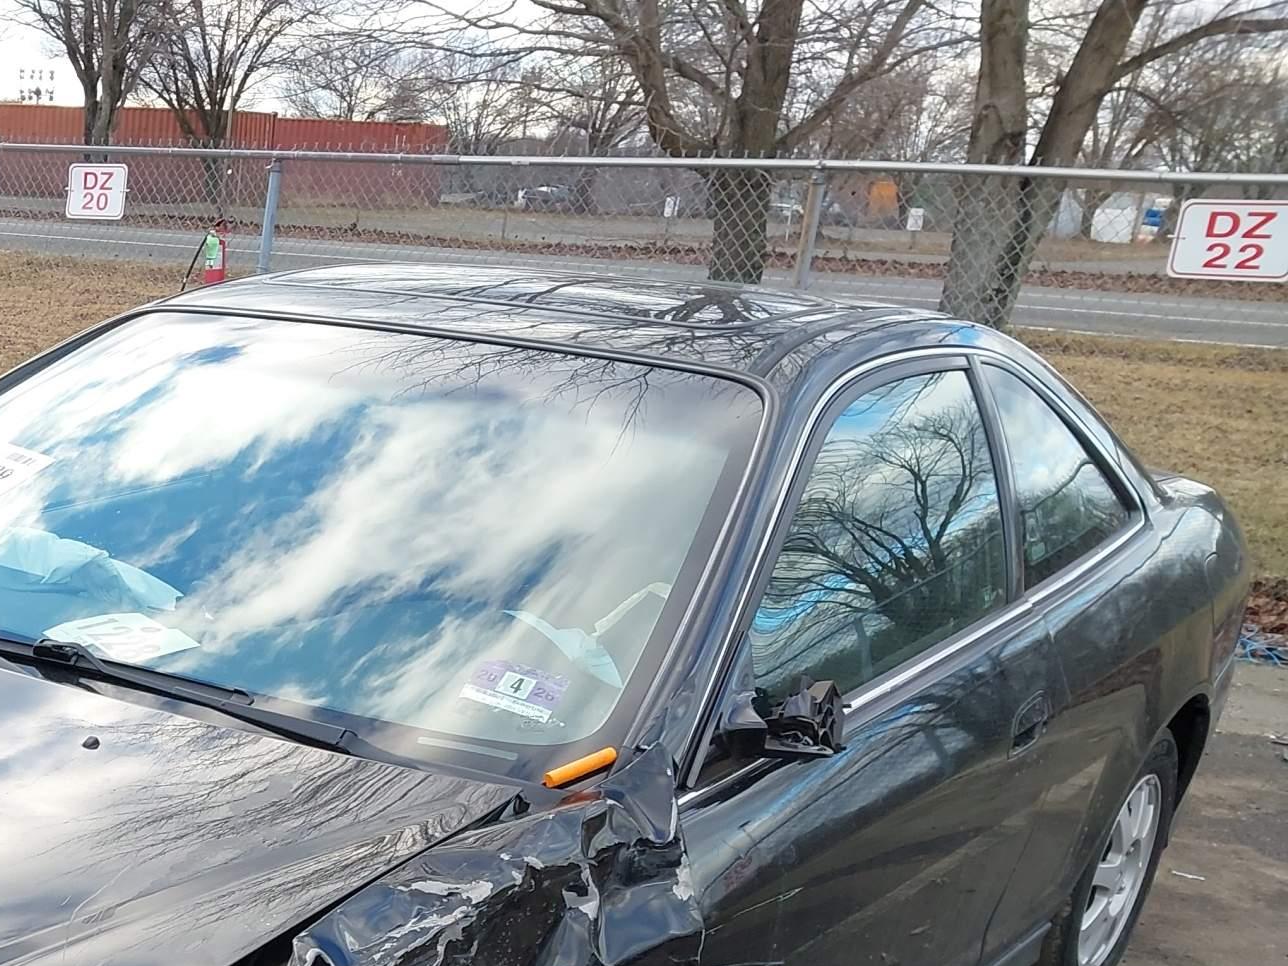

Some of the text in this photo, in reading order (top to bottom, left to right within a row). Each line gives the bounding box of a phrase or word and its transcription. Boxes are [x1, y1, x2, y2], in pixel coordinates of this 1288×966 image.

[83, 172, 114, 190] DZ
[81, 192, 109, 211] 20
[1205, 211, 1279, 239] DZ
[1201, 242, 1264, 270] 22
[509, 677, 525, 694] 4
